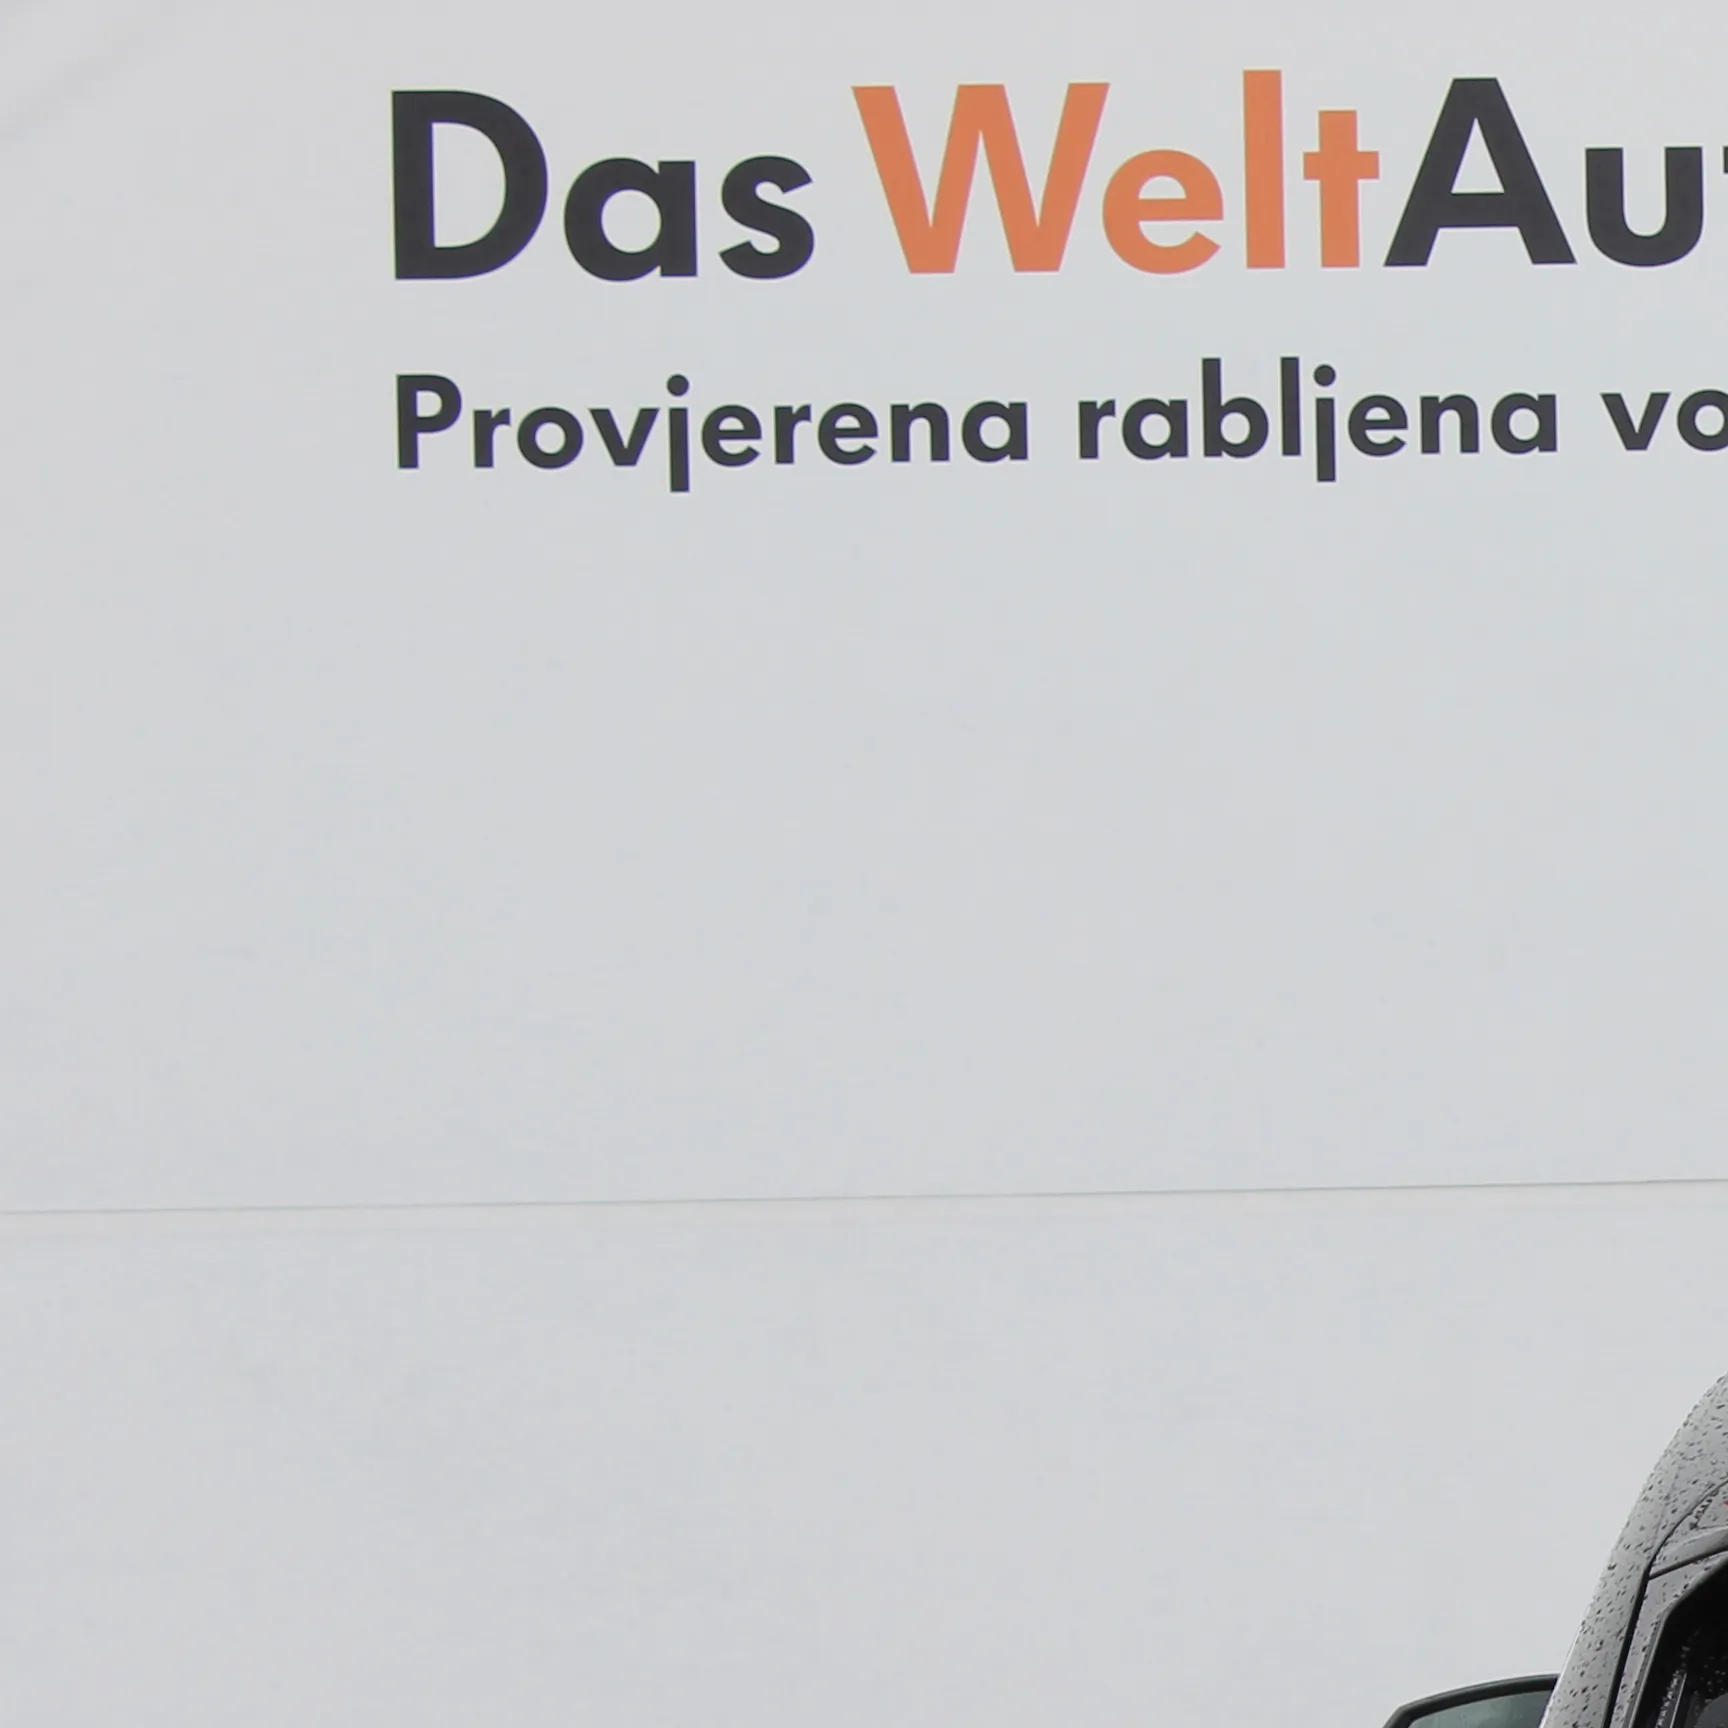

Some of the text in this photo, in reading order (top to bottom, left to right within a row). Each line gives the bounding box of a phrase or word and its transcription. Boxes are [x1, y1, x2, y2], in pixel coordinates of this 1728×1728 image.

[391, 89, 815, 282] Das
[396, 374, 1029, 493] Provjerena
[1078, 356, 1558, 483] rabljena
